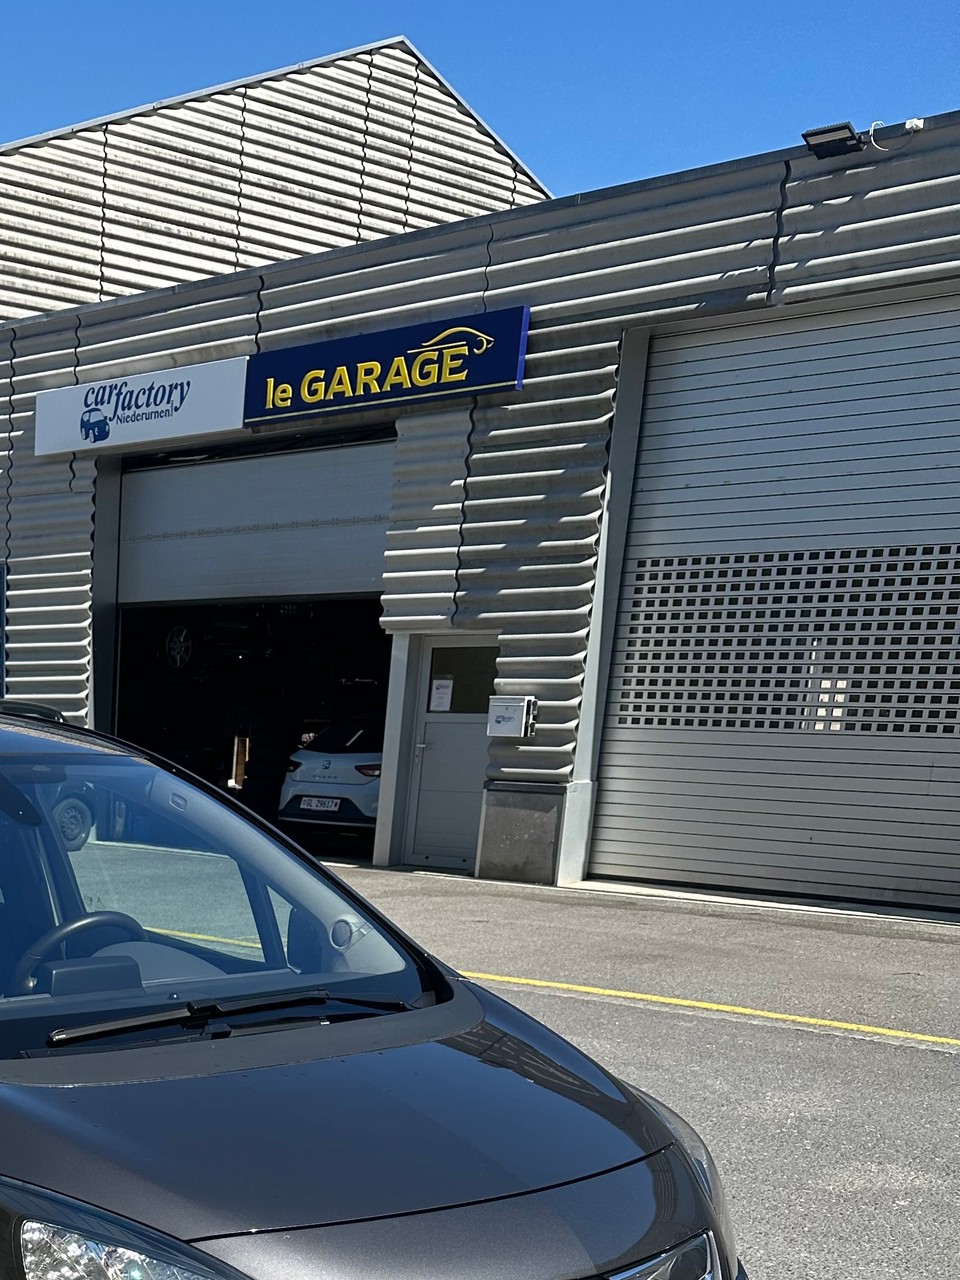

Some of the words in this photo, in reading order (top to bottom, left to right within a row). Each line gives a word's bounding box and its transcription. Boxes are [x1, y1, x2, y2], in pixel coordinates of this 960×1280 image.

[265, 378, 293, 409] le
[300, 346, 469, 404] GARAGE
[83, 380, 191, 422] carfactory
[116, 407, 171, 425] Niederurnen
